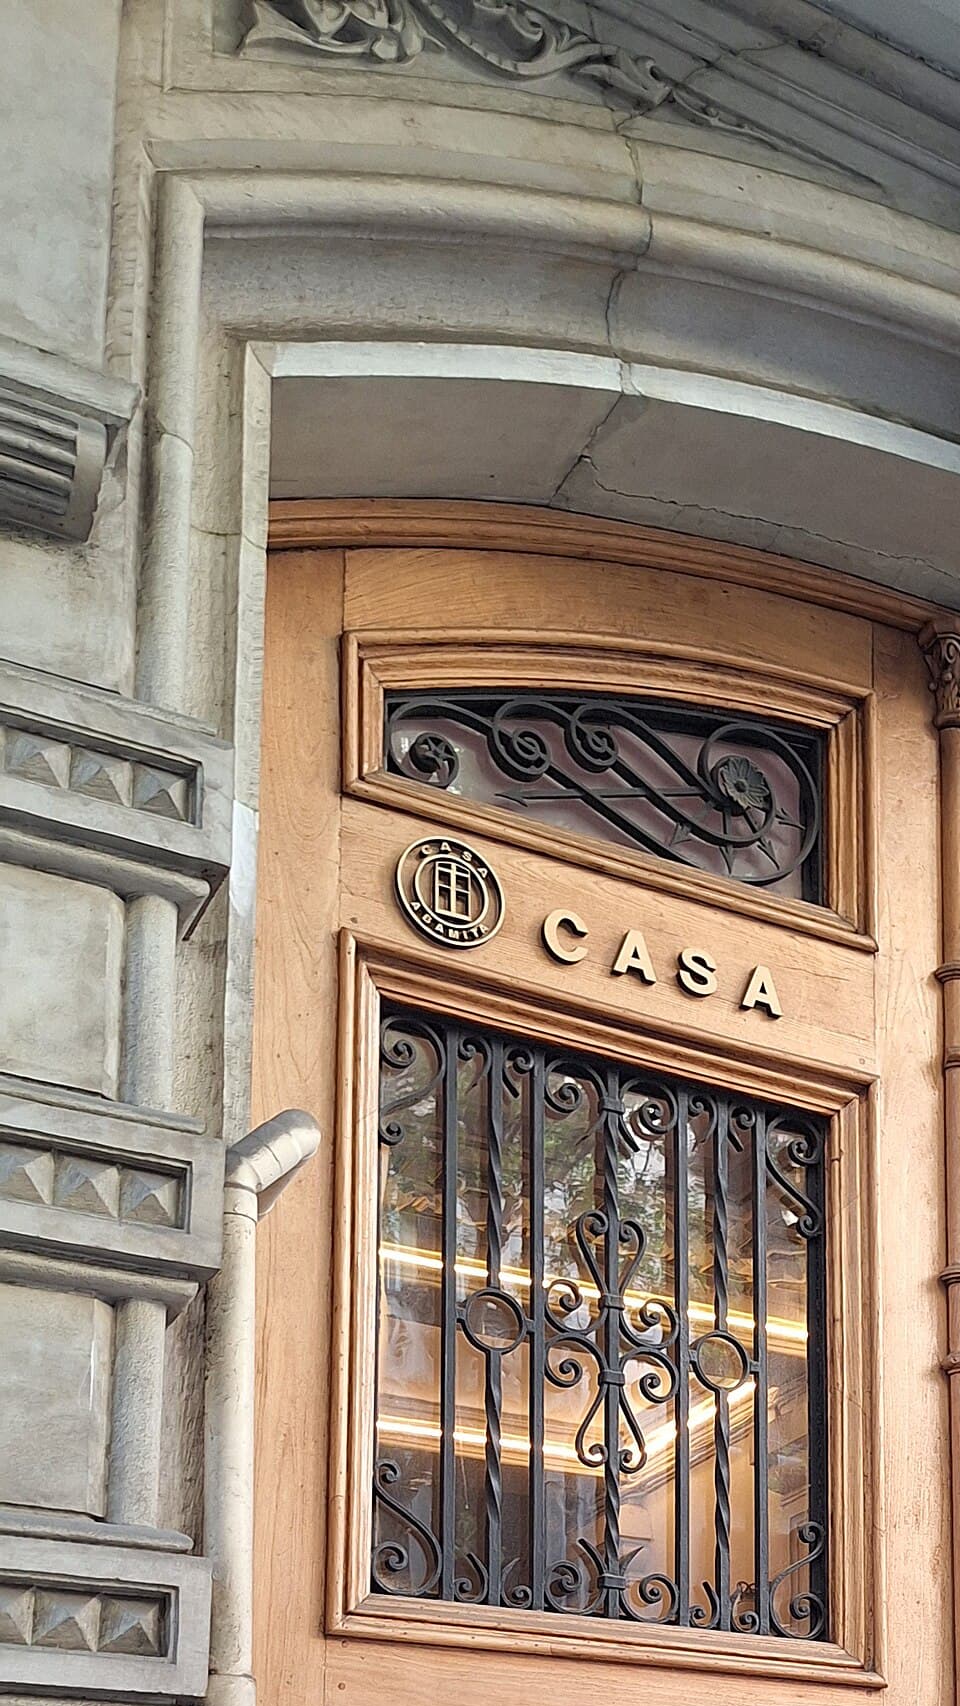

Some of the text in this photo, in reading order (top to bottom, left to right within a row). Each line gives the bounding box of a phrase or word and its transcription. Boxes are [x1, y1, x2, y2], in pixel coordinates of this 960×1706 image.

[421, 841, 489, 879] CASA
[410, 901, 489, 940] ABAMITA
[541, 908, 785, 1019] CASA
